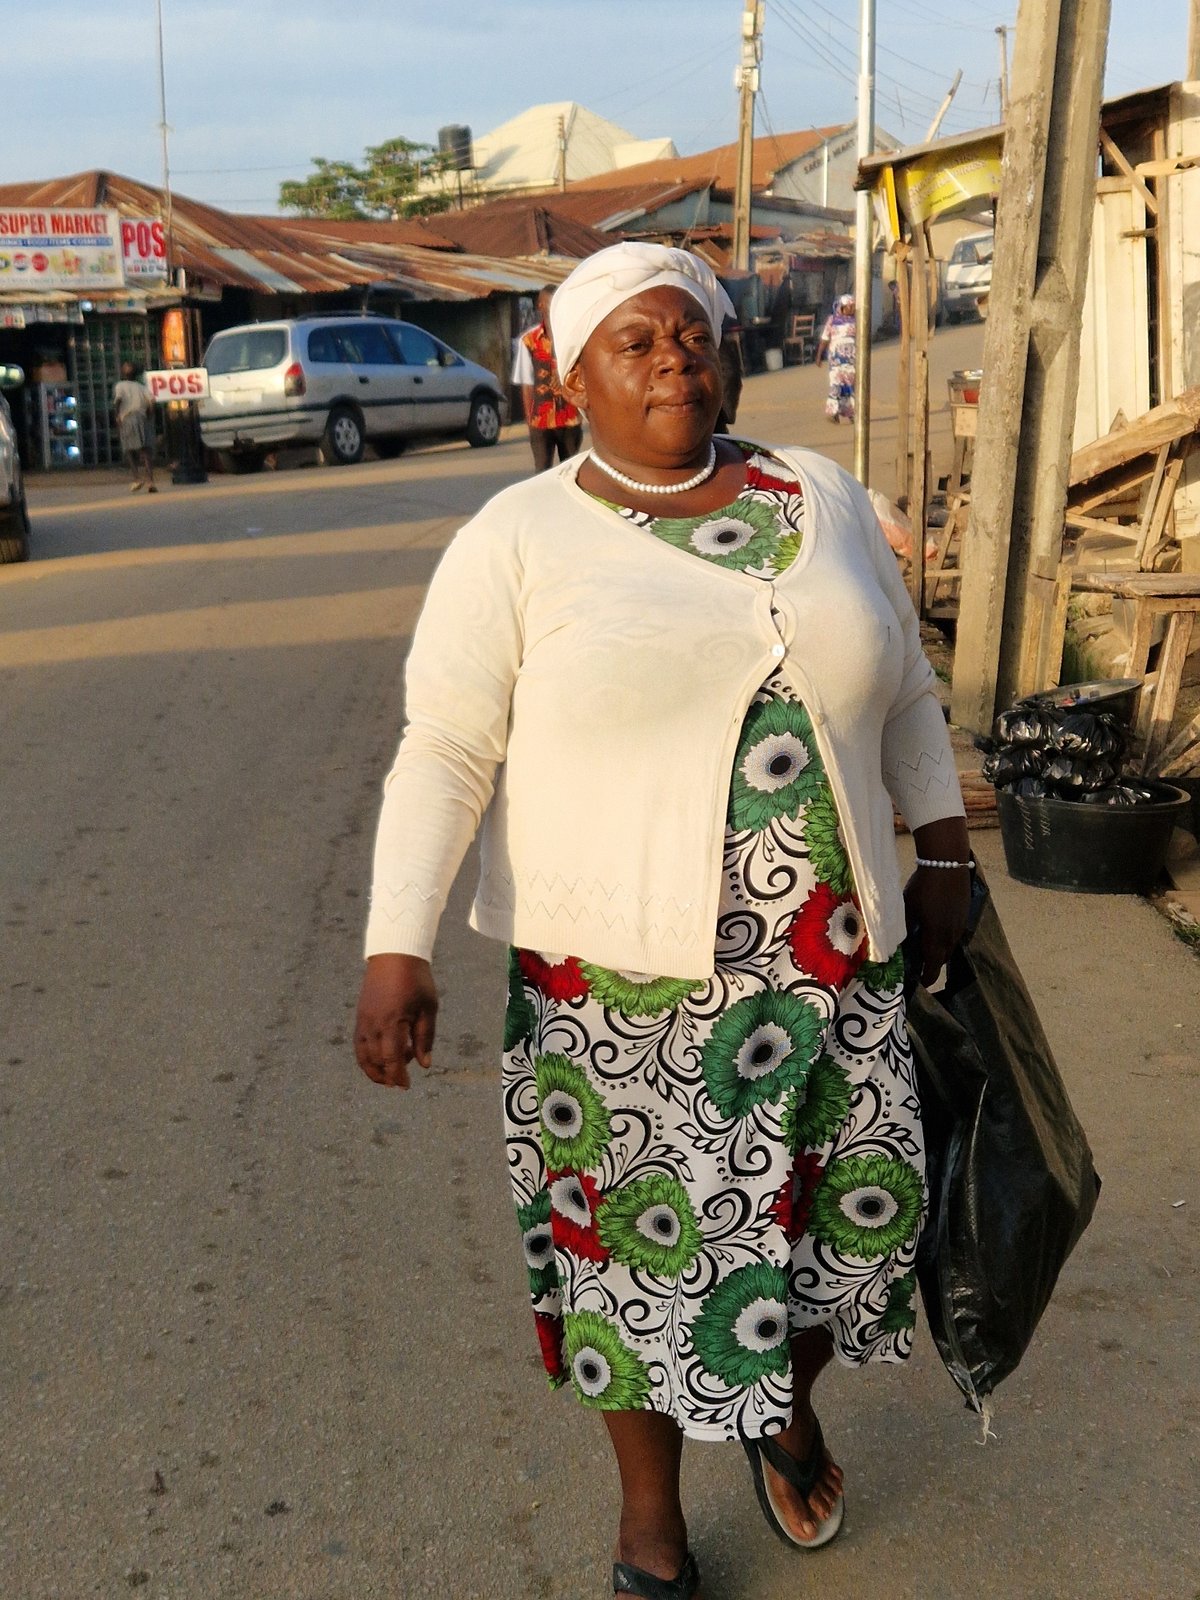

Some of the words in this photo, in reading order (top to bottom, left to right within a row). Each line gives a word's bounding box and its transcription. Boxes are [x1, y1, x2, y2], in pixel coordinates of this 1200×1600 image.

[0, 213, 47, 234] SUPER
[50, 213, 108, 234] MARKET
[121, 222, 167, 257] POS
[151, 373, 203, 396] POS
